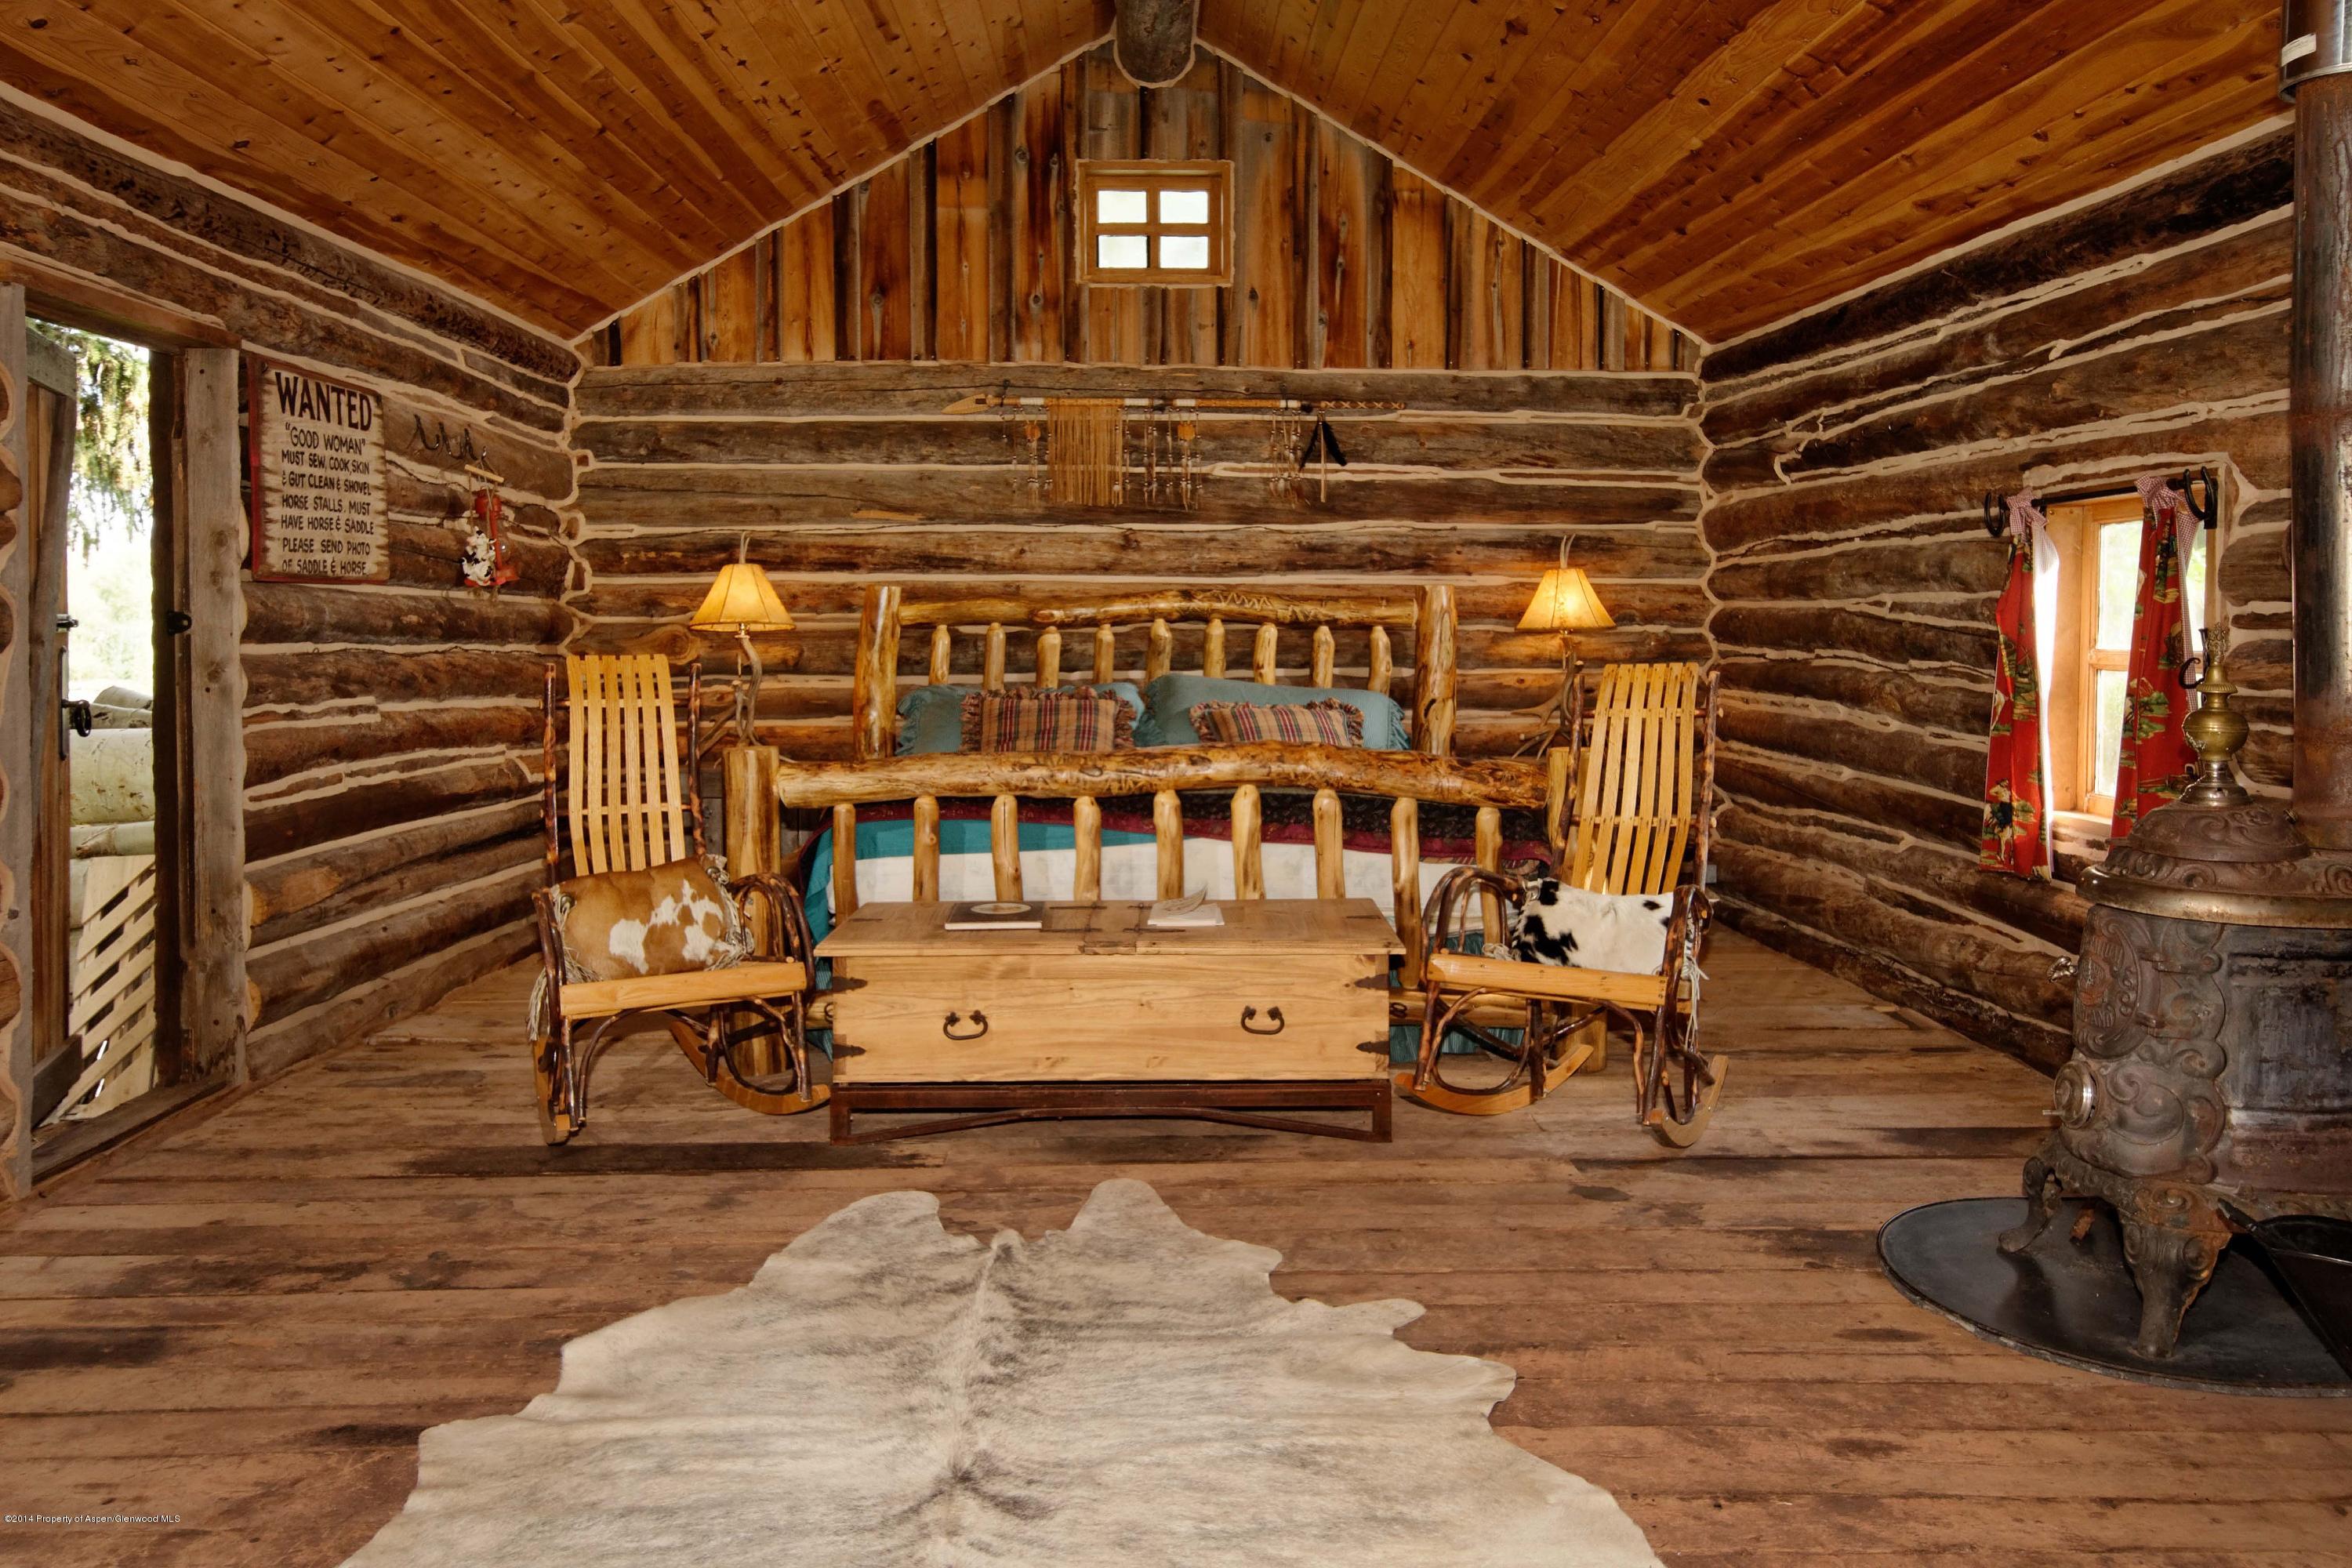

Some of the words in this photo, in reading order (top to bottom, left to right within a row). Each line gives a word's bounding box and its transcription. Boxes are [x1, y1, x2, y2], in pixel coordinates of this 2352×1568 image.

[275, 372, 372, 431] WANTED
[281, 448, 305, 466] MUST
[289, 470, 306, 488] GUT
[308, 474, 335, 490] CLEAN
[336, 477, 341, 492] &
[344, 478, 372, 496] SHOVEL
[282, 494, 308, 510] HORSE
[314, 495, 346, 513] STALLS.
[349, 500, 371, 516] MUST
[281, 514, 303, 530] HAVE
[307, 517, 334, 531] HORSE
[336, 515, 341, 532] &
[345, 518, 374, 535] SADDLE
[282, 537, 314, 553] PLEASE
[321, 539, 343, 554] SEND
[347, 540, 370, 555] PHOTO
[282, 558, 292, 572] OF
[297, 559, 328, 574] SADDLE
[330, 557, 336, 575] &
